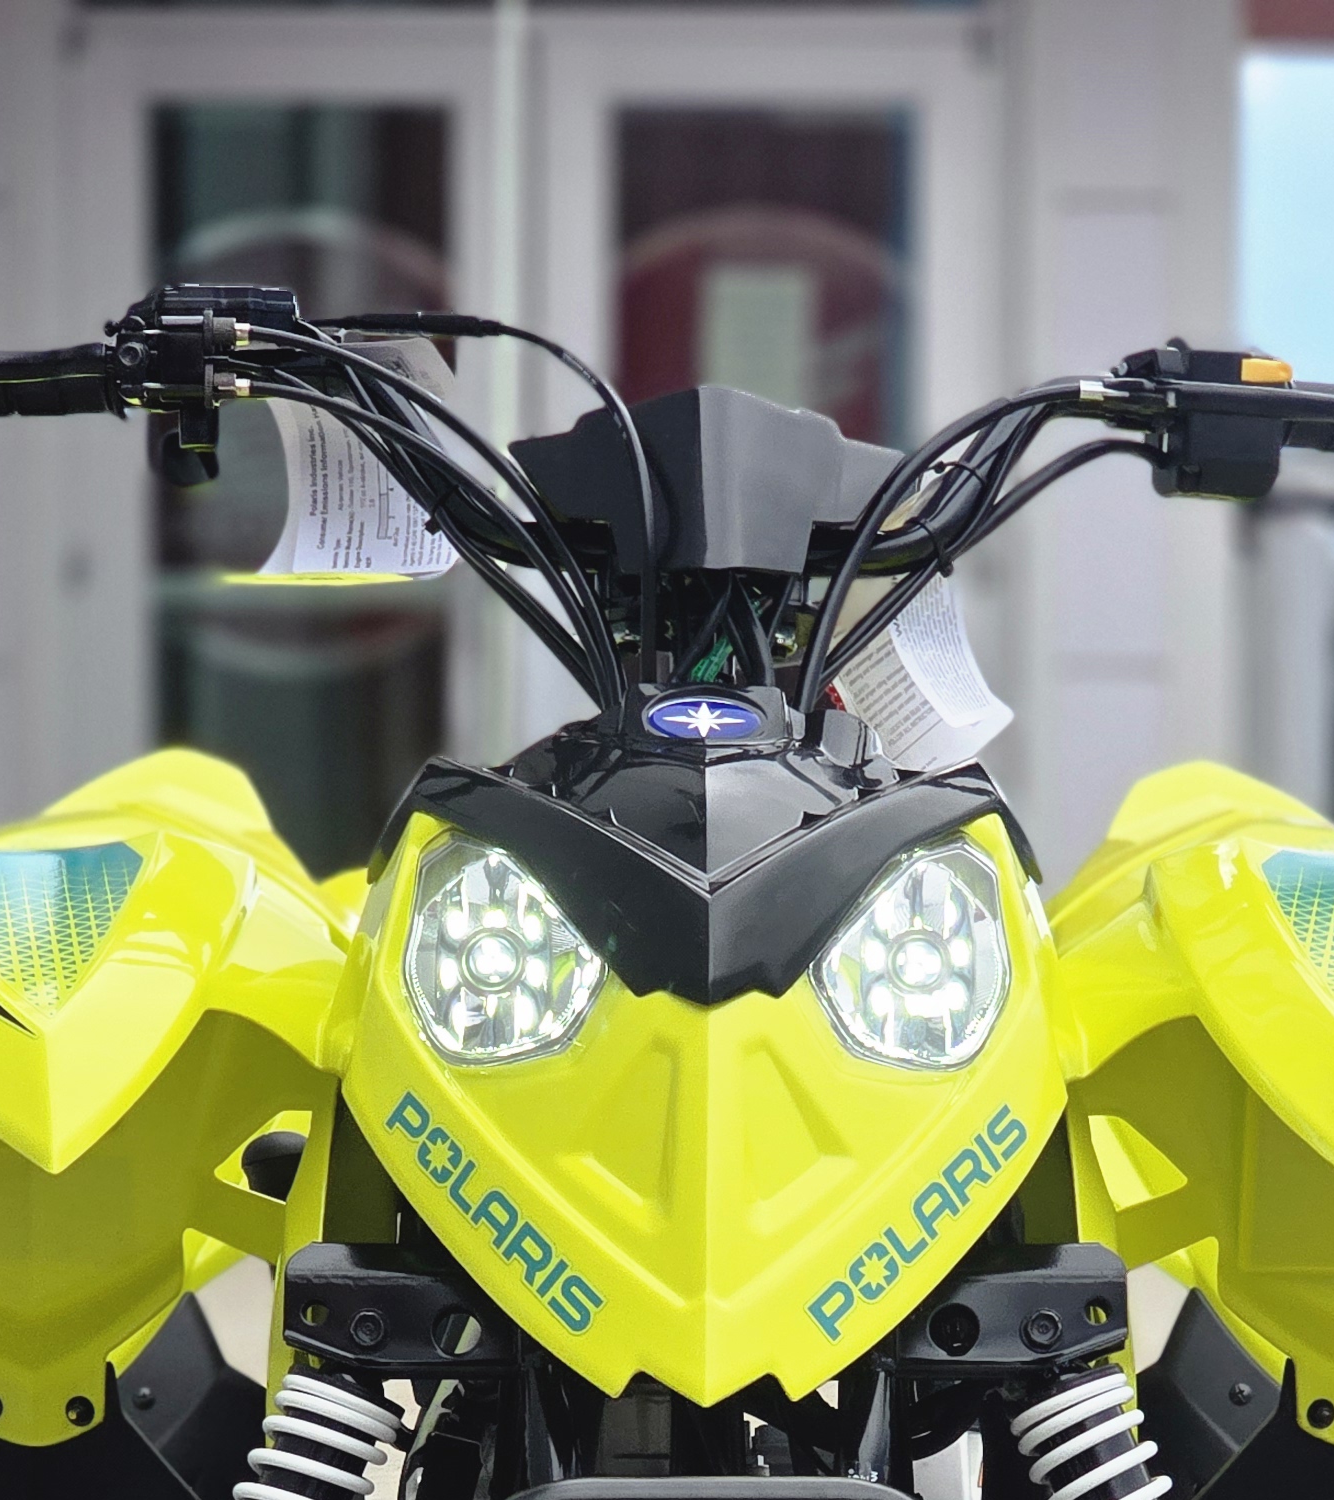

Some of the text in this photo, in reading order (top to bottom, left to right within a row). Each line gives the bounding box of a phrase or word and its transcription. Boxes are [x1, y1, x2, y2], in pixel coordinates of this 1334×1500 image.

[309, 443, 317, 487] Industries
[317, 420, 328, 472] Information
[309, 488, 317, 517] Polaris
[320, 473, 329, 516] Emissions
[317, 516, 327, 550] Consumer
[385, 1092, 603, 1333] POLARIS
[808, 1104, 1028, 1341] POLARIS
